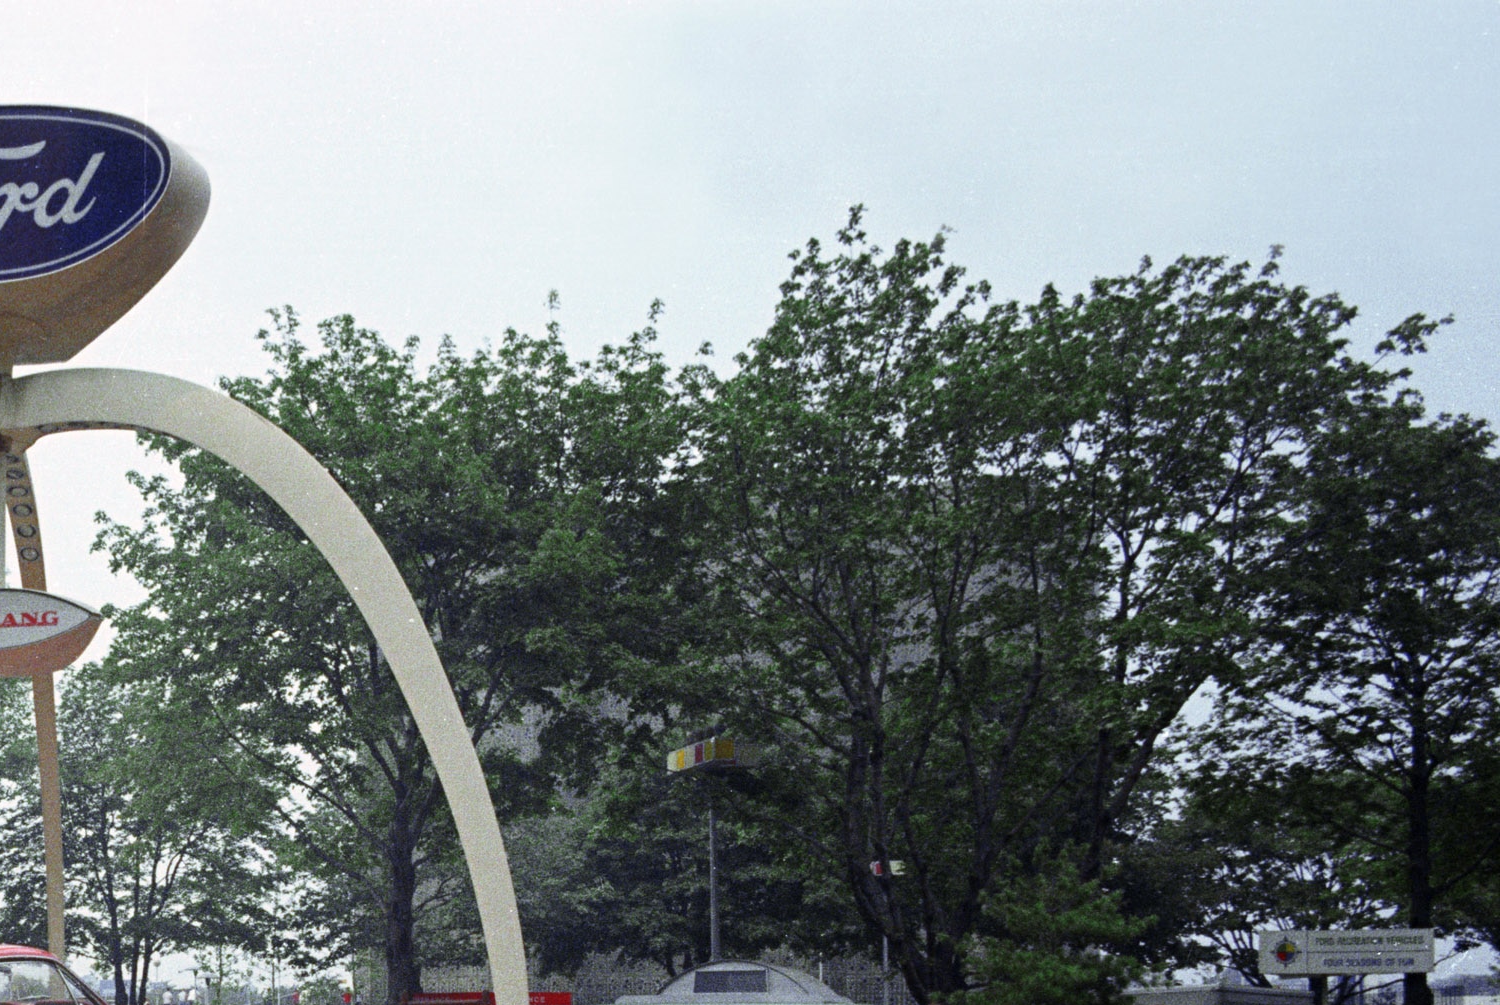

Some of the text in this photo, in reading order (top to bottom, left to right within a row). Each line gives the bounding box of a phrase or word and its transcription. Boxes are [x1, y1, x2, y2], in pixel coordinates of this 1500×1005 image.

[1386, 936, 1425, 945] VEHICLES
[1323, 958, 1343, 967] FOUR
[1346, 958, 1382, 967] SEASONS
[1385, 958, 1396, 966] OF
